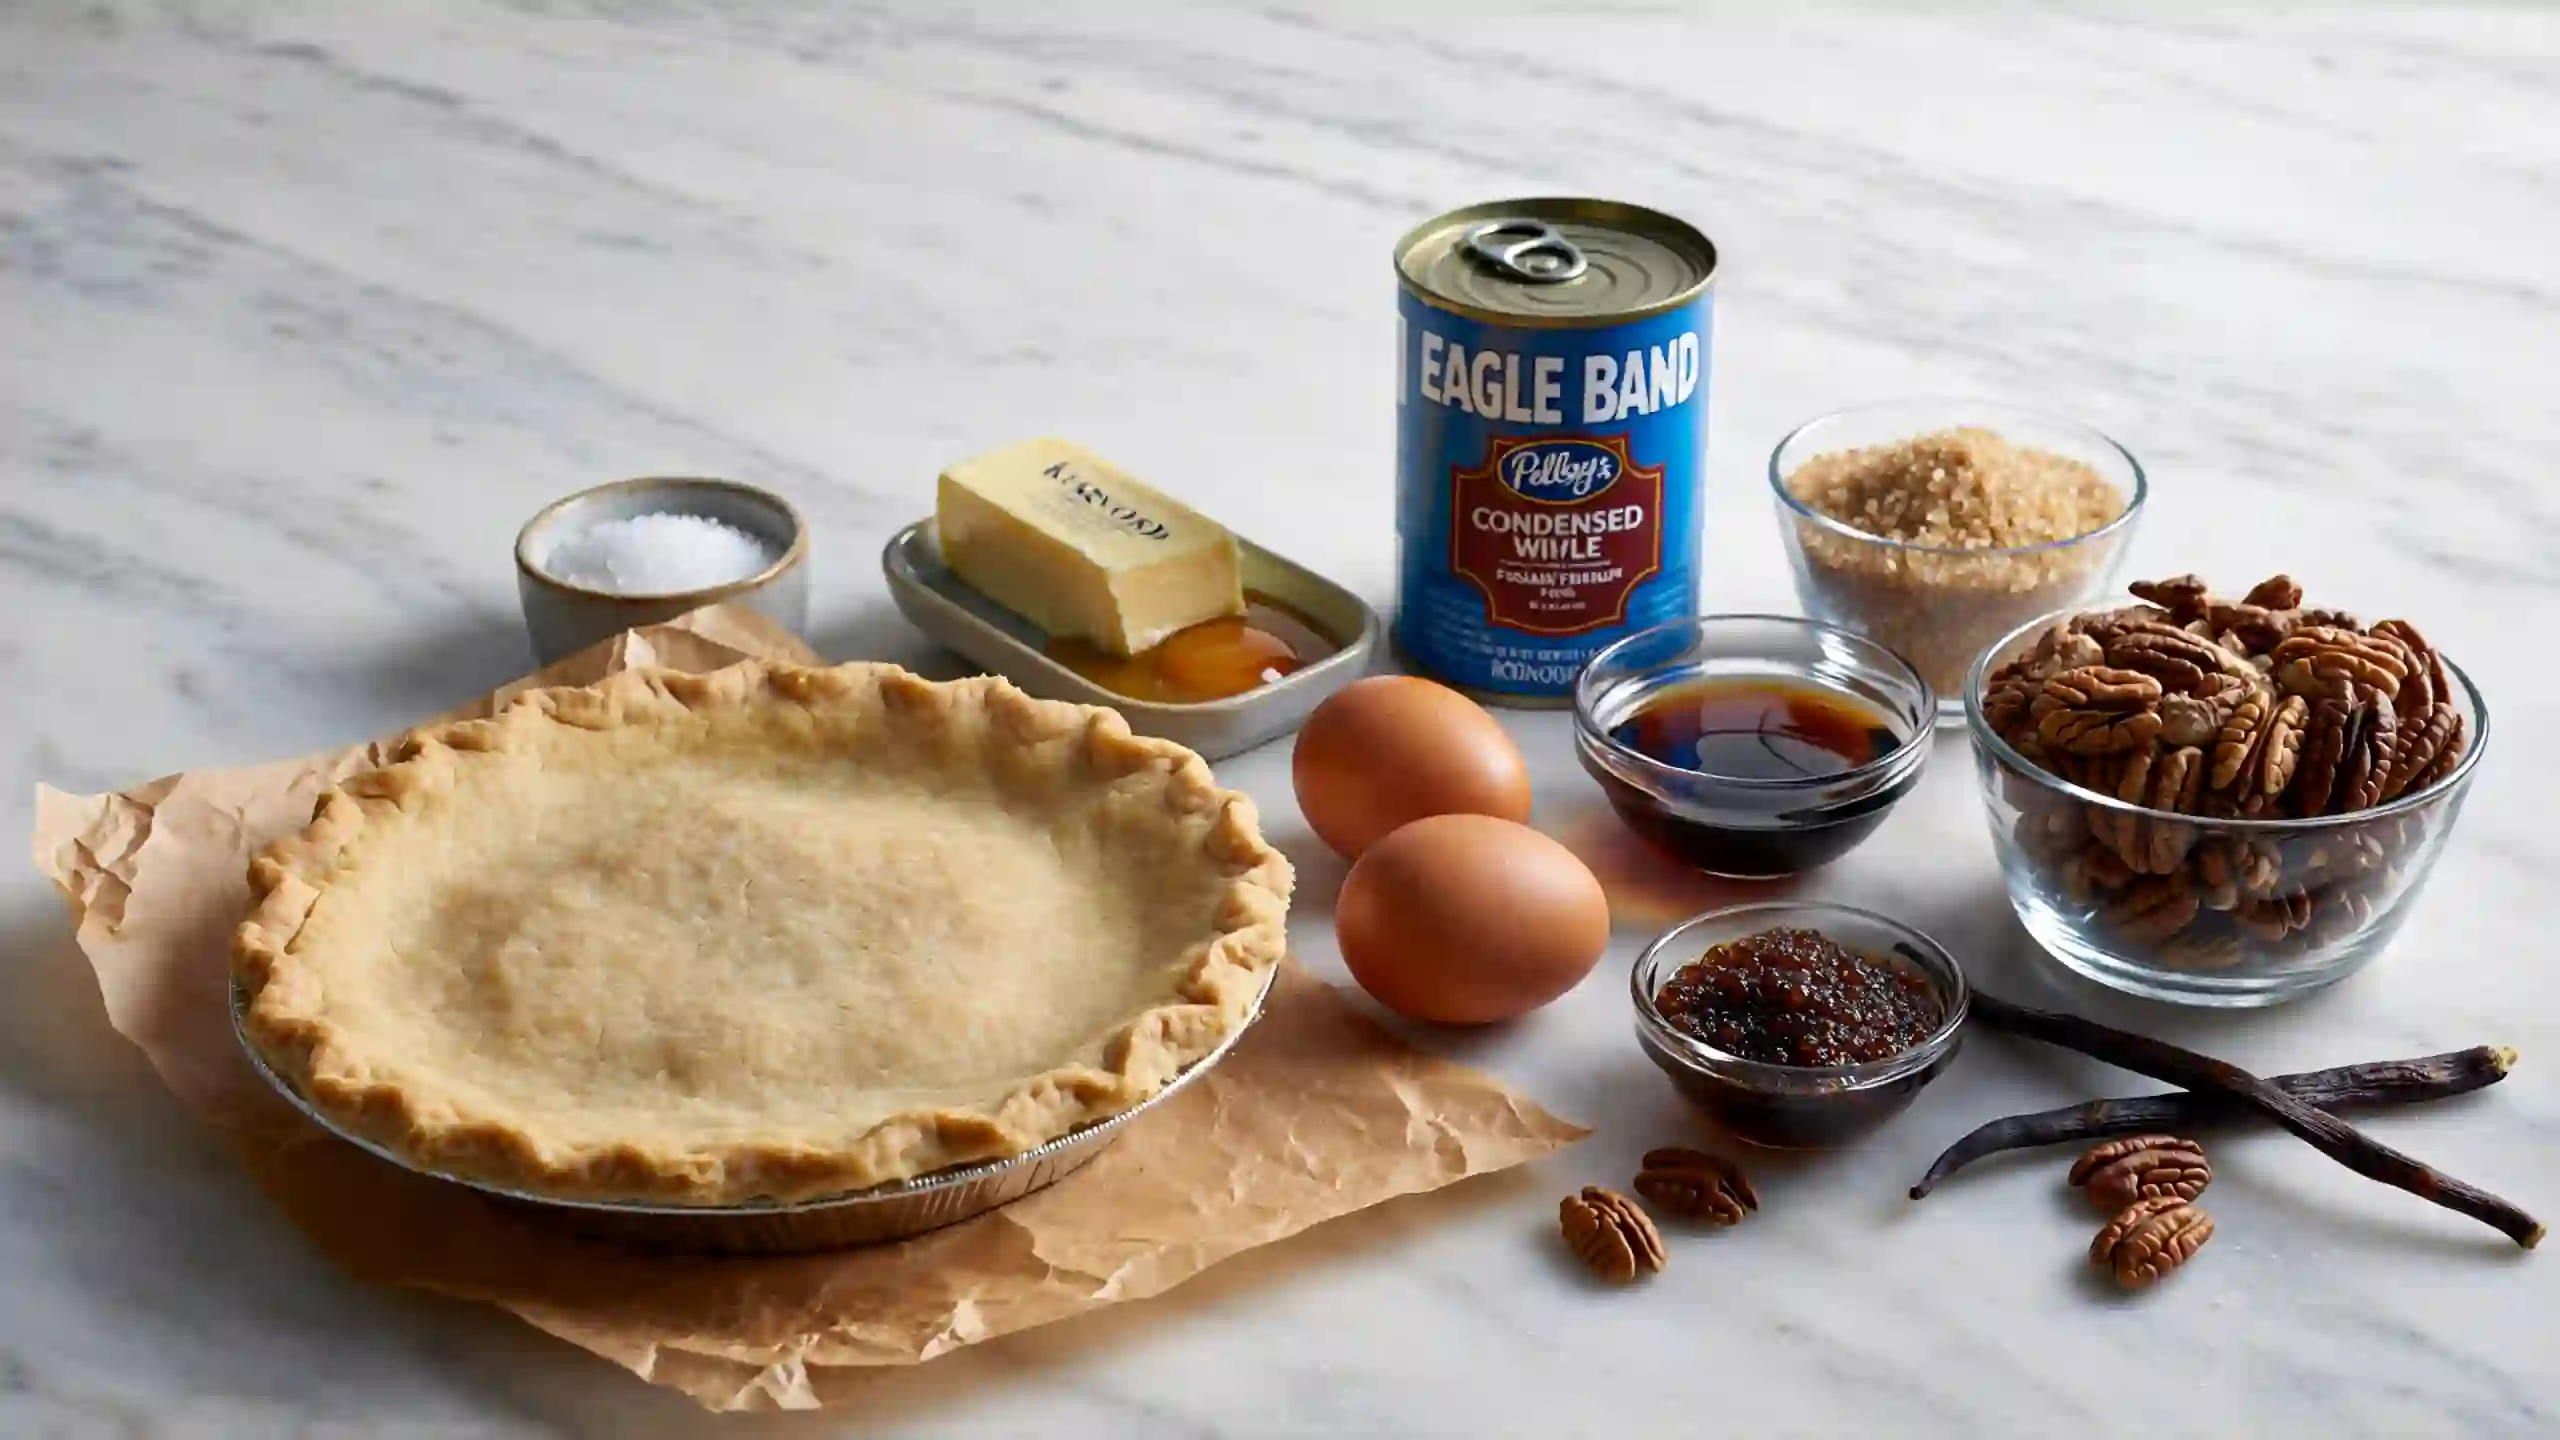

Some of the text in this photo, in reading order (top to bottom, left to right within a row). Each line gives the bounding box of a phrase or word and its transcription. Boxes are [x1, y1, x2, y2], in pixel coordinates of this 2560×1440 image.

[1421, 331, 1565, 424] EAGLE
[1583, 331, 1700, 424] BAND
[1472, 505, 1644, 536] CONDENSED
